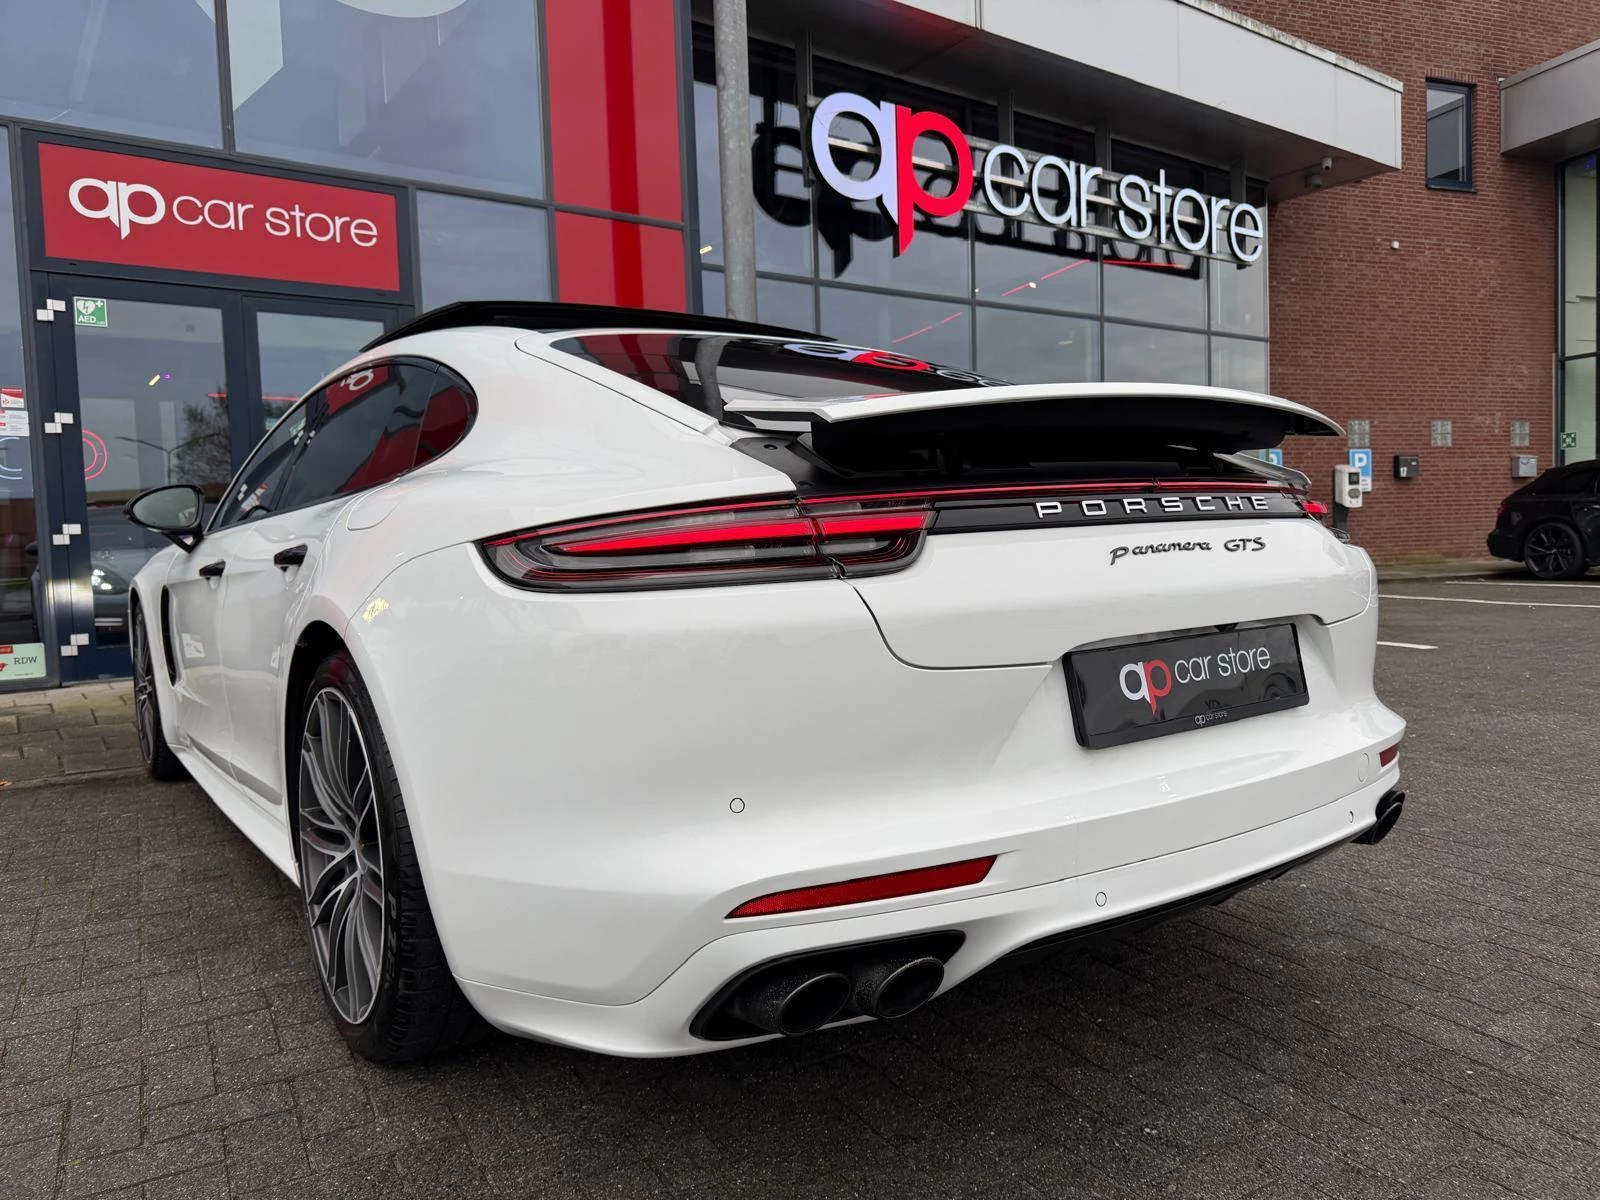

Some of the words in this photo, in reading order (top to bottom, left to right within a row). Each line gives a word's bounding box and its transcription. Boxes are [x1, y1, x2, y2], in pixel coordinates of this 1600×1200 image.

[982, 144, 1103, 228] car
[1117, 168, 1264, 263] store
[172, 195, 254, 231] car
[264, 204, 378, 247] store
[78, 315, 97, 323] AED
[1035, 495, 1269, 518] PORSCHE
[1110, 539, 1212, 565] Panamera
[1223, 536, 1266, 552] GTS
[14, 656, 37, 665] RDW
[1174, 654, 1212, 684] car
[1217, 647, 1271, 677] store
